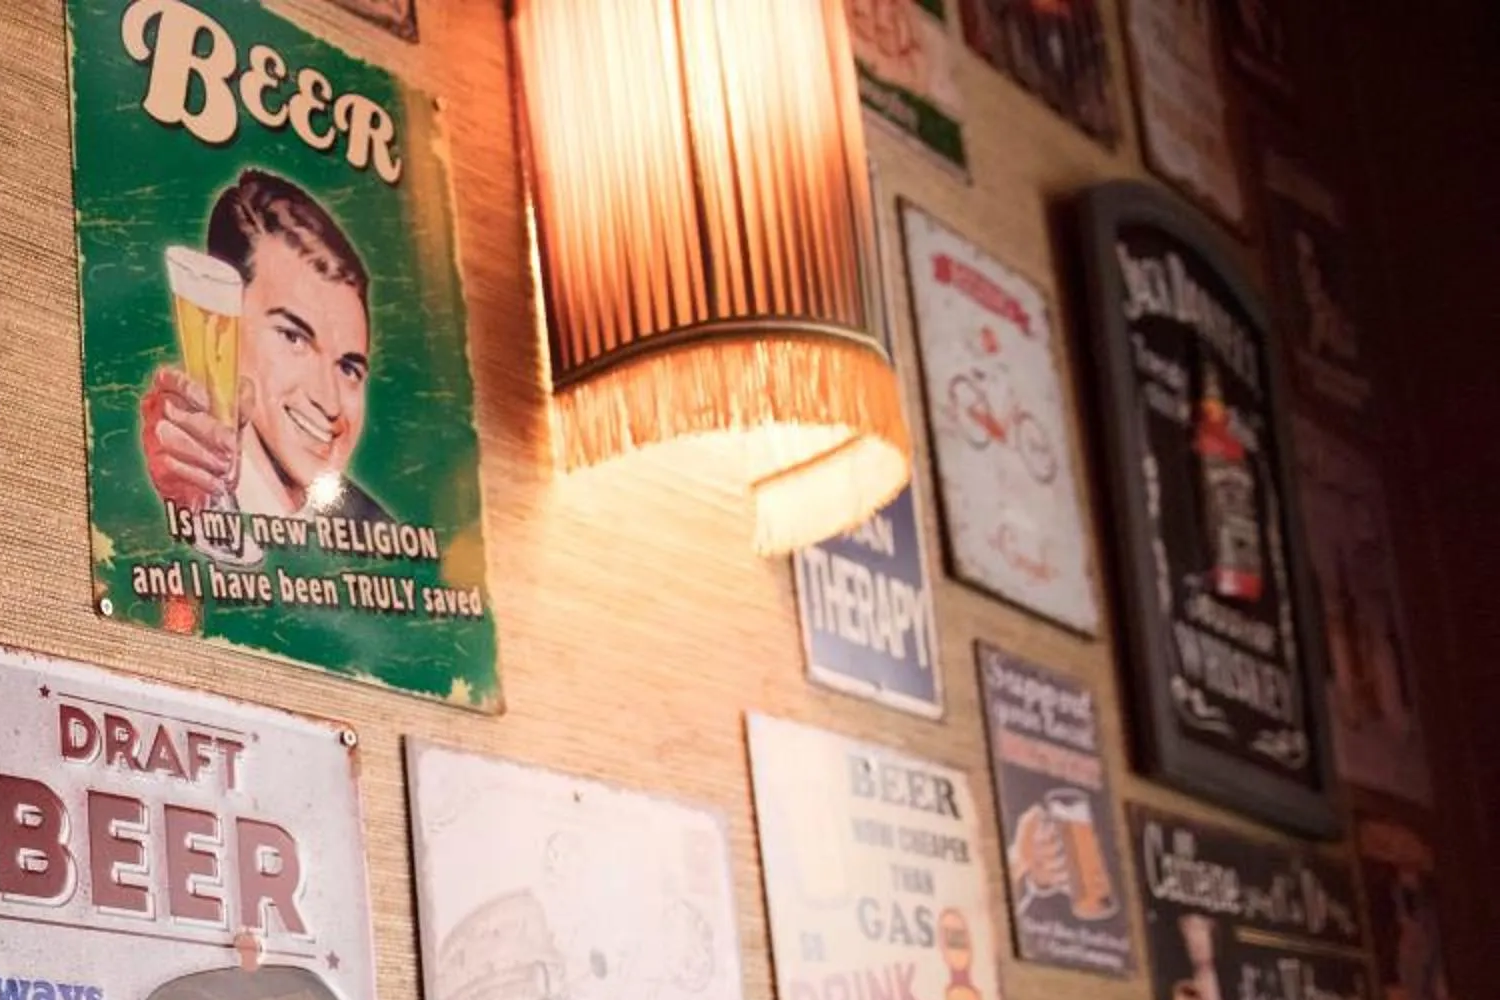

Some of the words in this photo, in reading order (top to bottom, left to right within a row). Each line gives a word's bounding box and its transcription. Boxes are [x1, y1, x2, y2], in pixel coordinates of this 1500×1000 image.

[121, 0, 403, 185] BEER
[166, 502, 192, 540] Is
[202, 509, 242, 551] my
[251, 512, 307, 548] new
[315, 514, 439, 561] RELIGION
[132, 561, 183, 598] and
[190, 560, 202, 598] I
[211, 562, 271, 602] have
[278, 567, 337, 607] been
[342, 572, 416, 612] TRULY
[422, 582, 484, 618] saved
[802, 545, 930, 670] THERAPY
[58, 702, 246, 791] DRAFT
[850, 754, 963, 822] BEER
[856, 895, 937, 949] GAS
